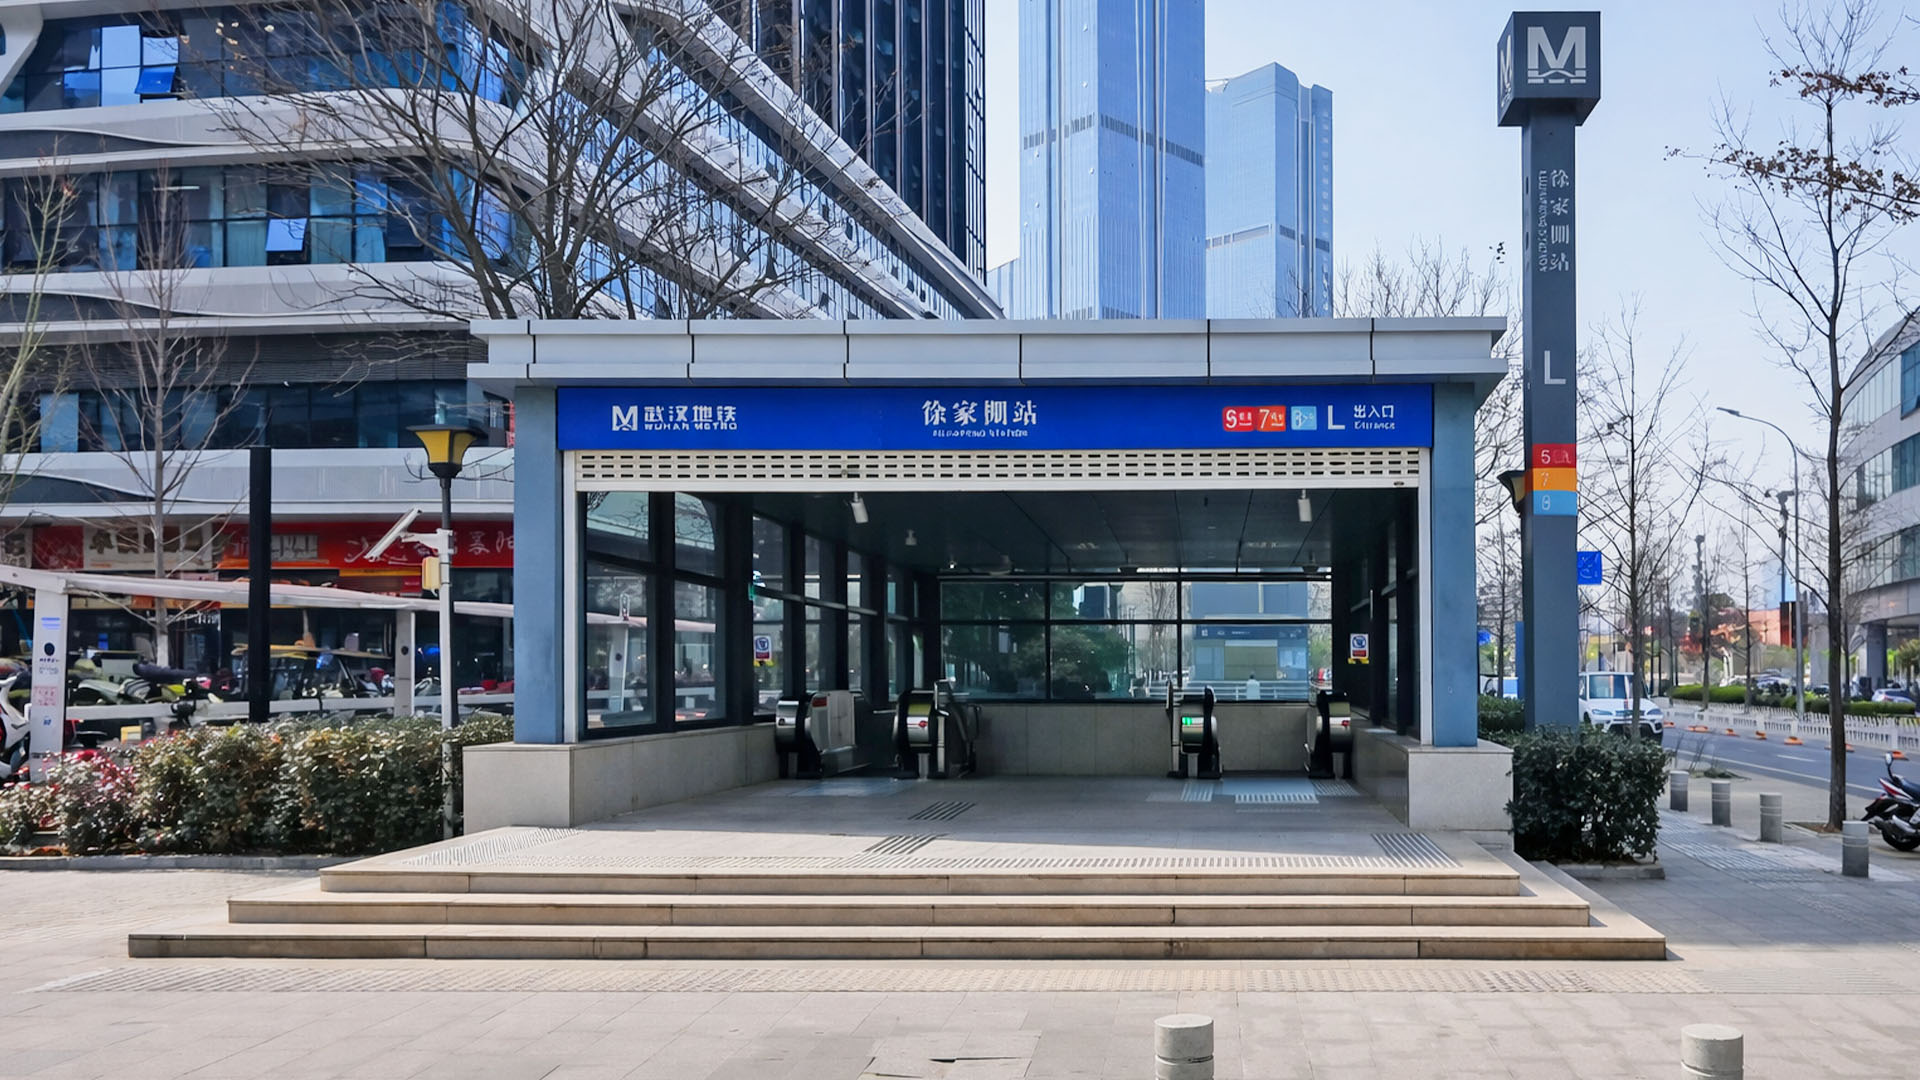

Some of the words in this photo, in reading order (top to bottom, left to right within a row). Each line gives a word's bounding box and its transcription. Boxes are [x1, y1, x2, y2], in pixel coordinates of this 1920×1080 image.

[1527, 26, 1587, 84] M
[1544, 350, 1566, 385] L
[612, 405, 639, 432] M
[1259, 408, 1271, 429] 7
[1327, 405, 1346, 430] L
[1353, 404, 1395, 419] 出入口
[1541, 449, 1551, 465] 5
